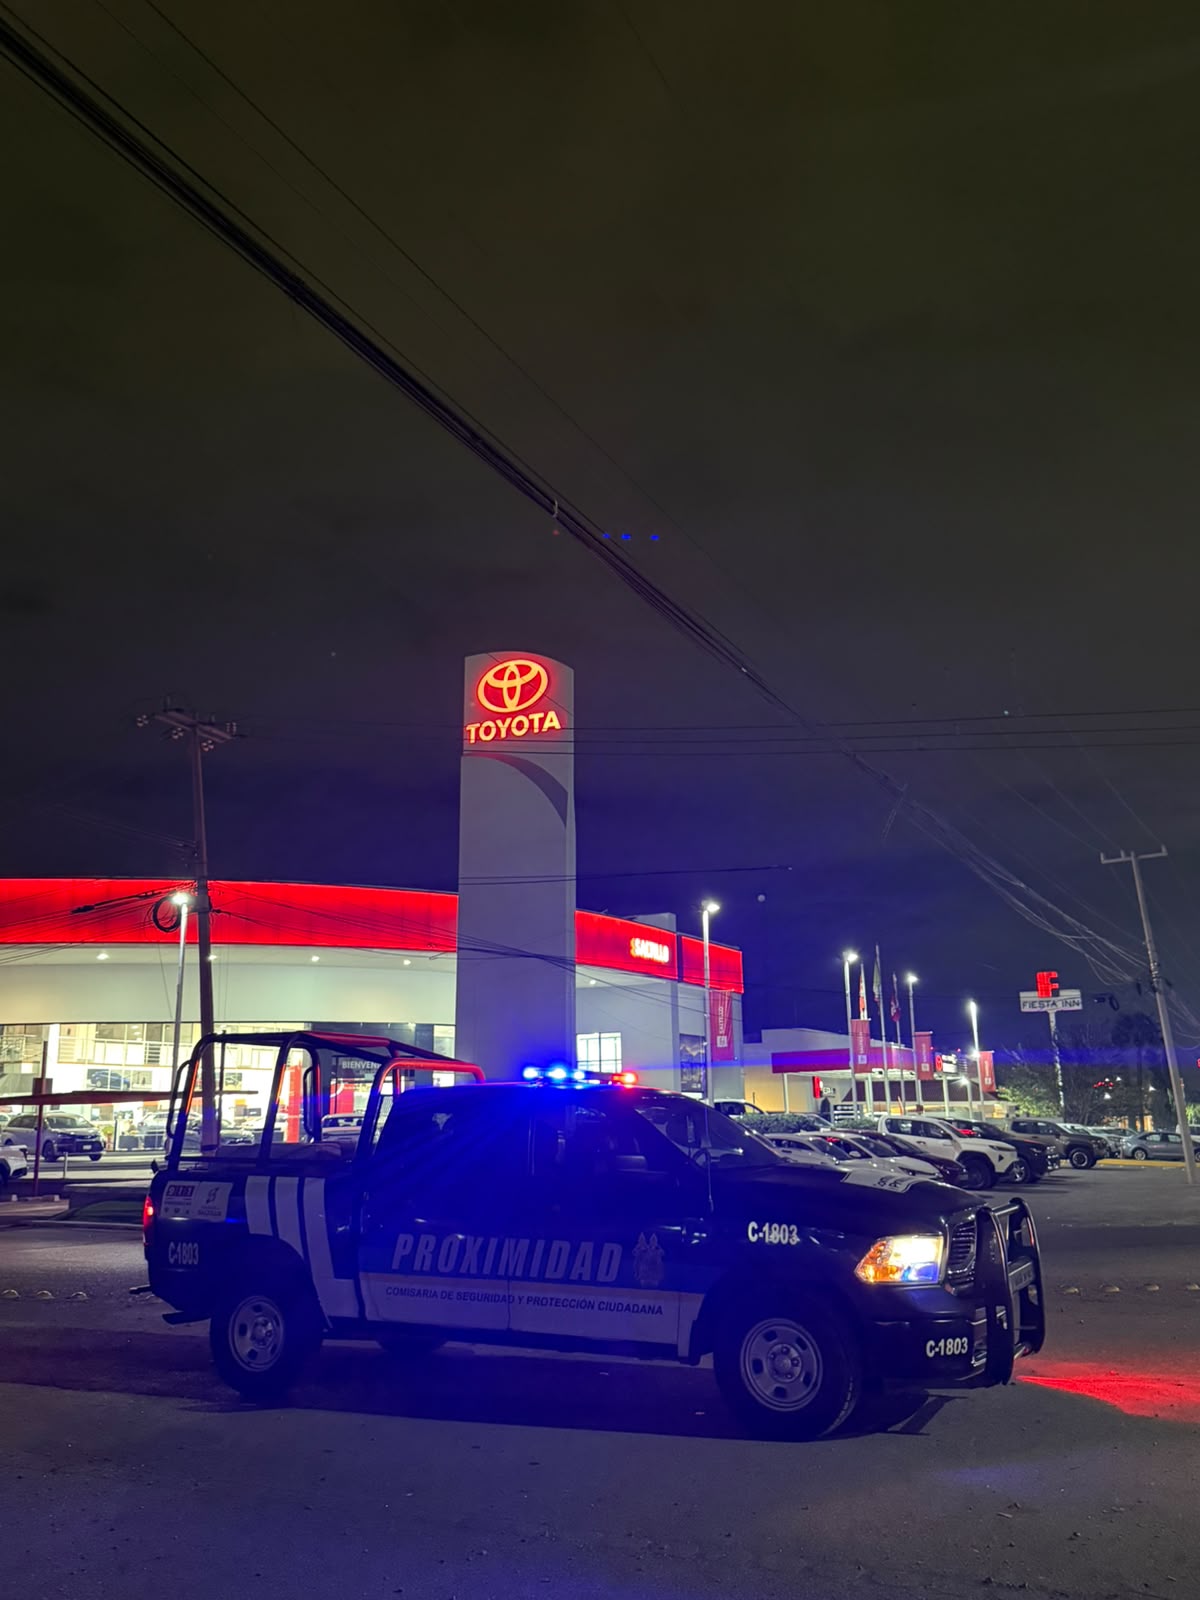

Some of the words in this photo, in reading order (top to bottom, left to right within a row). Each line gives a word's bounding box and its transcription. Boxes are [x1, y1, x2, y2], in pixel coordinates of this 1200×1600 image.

[466, 710, 561, 744] TOYOTA
[1036, 971, 1059, 998] F
[1022, 1000, 1057, 1009] FIESTA
[1061, 999, 1080, 1008] INN
[747, 1221, 799, 1246] C-1803
[168, 1241, 199, 1265] C-1803
[391, 1233, 623, 1283] PROXIMIDAD
[440, 1290, 454, 1300] DE
[456, 1291, 515, 1304] SEGURIDAD
[518, 1295, 525, 1304] Y
[598, 1300, 663, 1316] CIUDADANA
[926, 1337, 968, 1358] C-1803
